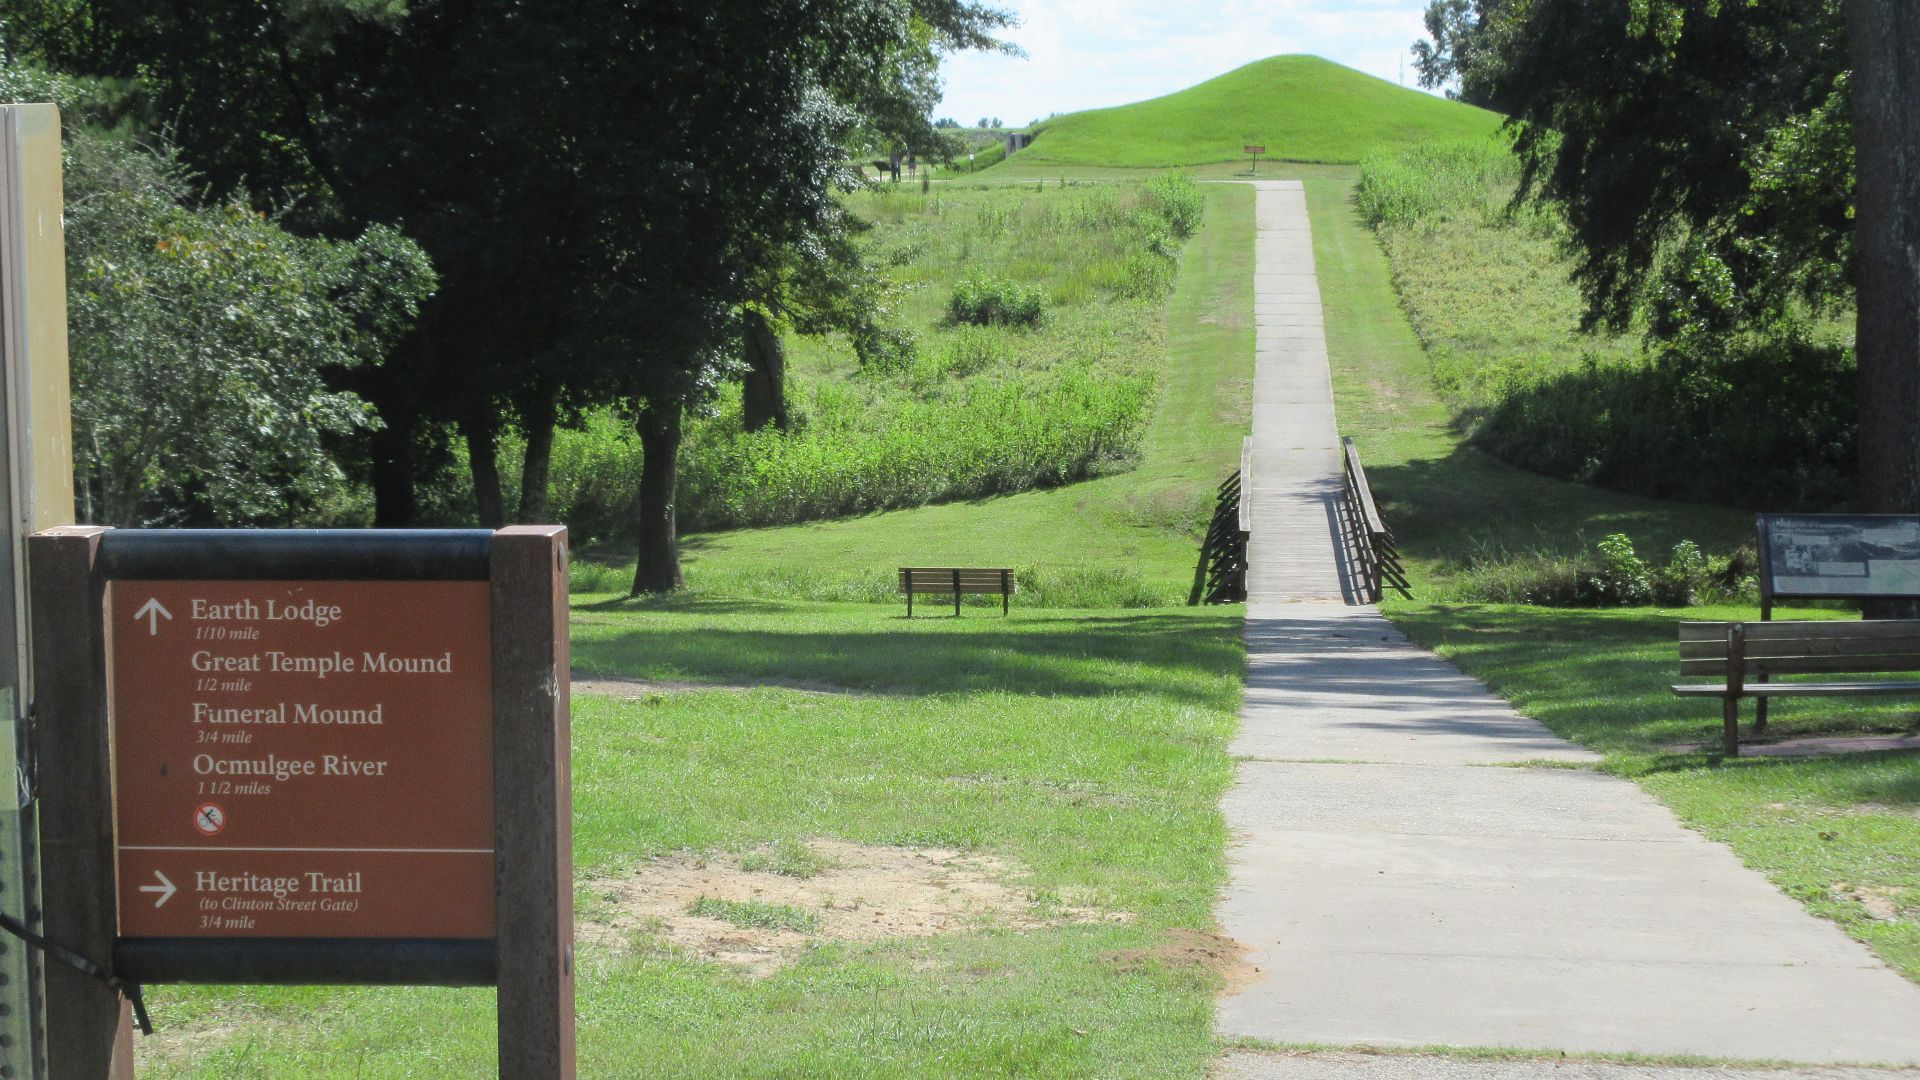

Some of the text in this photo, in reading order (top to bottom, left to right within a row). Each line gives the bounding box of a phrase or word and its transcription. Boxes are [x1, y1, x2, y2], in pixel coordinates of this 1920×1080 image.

[191, 599, 341, 627] Earth Lodge
[196, 627, 259, 639] 1/10 mile
[191, 651, 452, 678] Great Temple Mound
[197, 678, 251, 691] 1/2 mile
[192, 703, 383, 724] Funeral Mound
[196, 730, 252, 743] 3/4 mile
[193, 754, 387, 781] Ocmulgee River
[198, 782, 271, 795] 1 1/2 miles
[195, 871, 362, 896] Heritage Trail
[200, 897, 358, 912] (to Clinton Street Gate)
[200, 915, 255, 928] 3/4 mile
